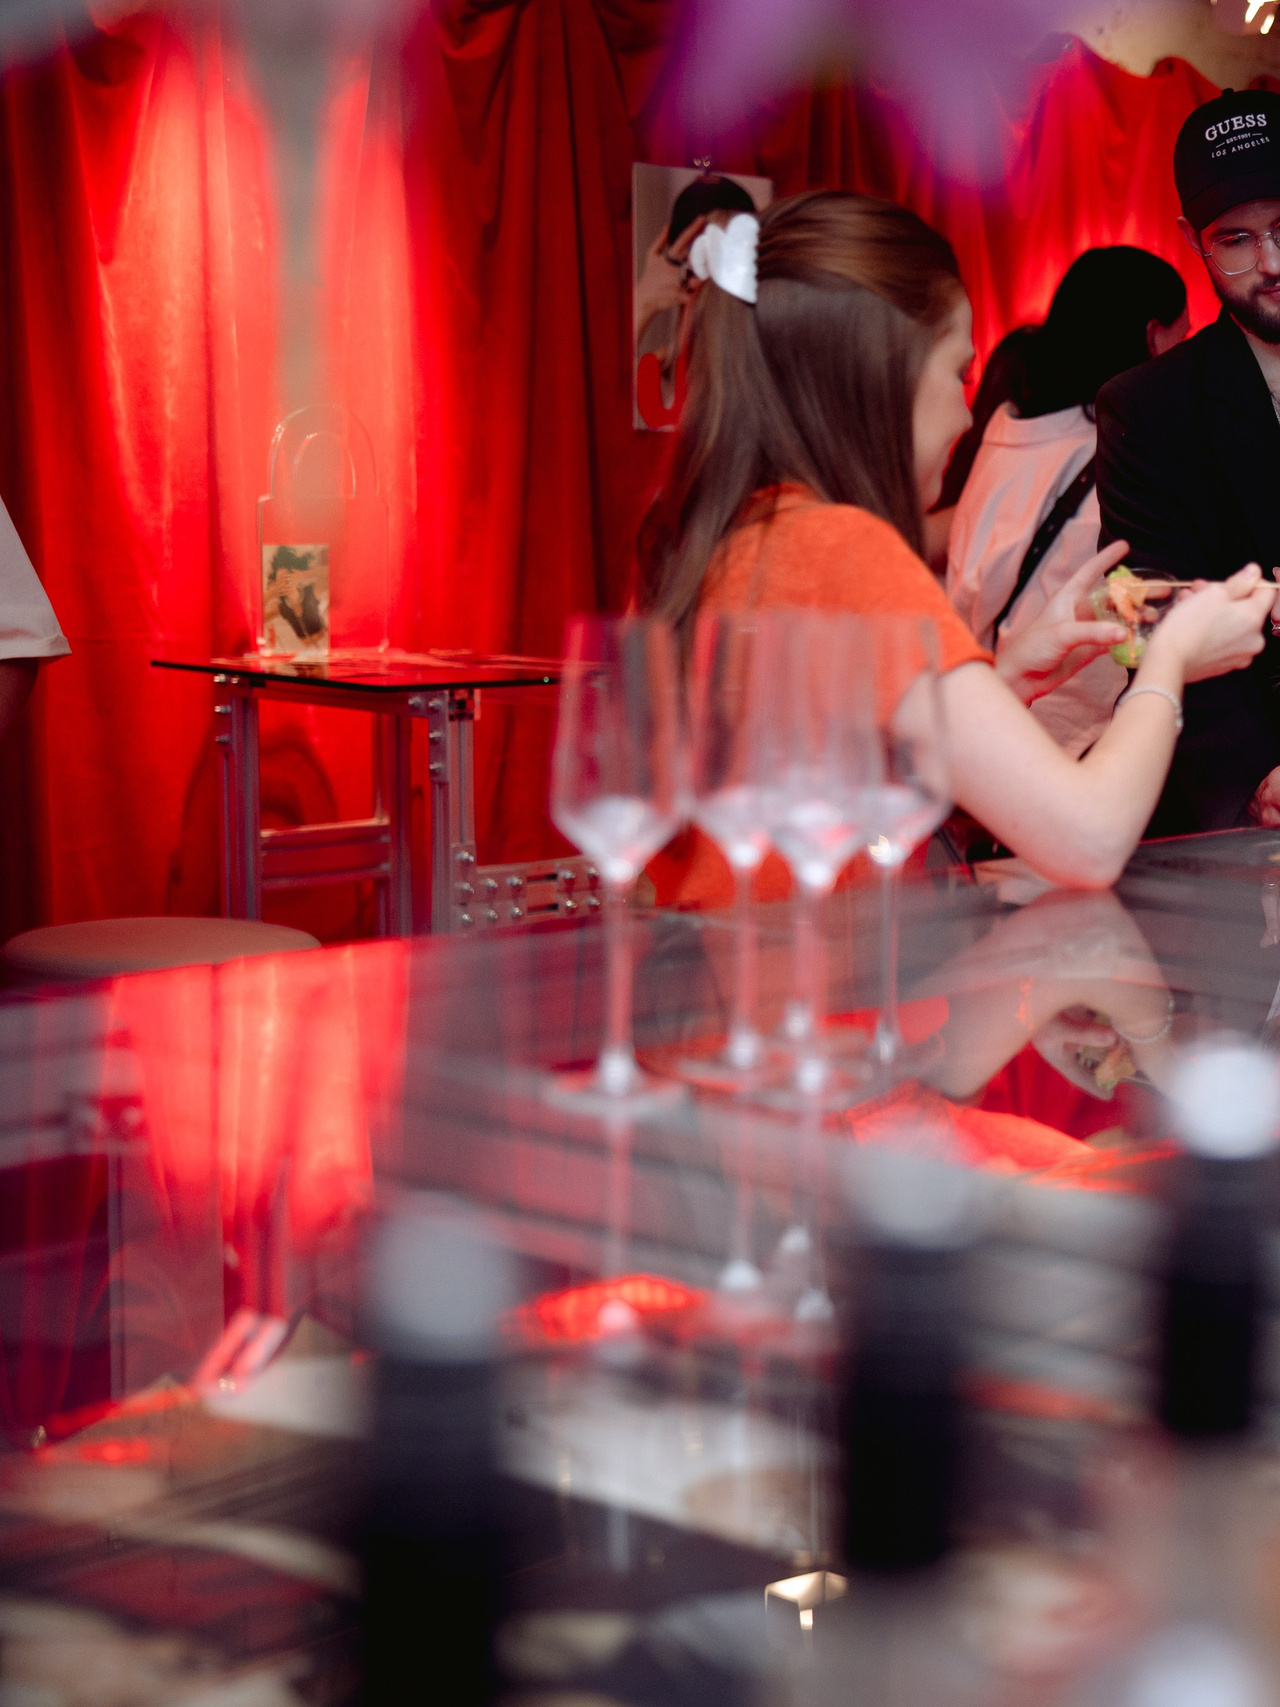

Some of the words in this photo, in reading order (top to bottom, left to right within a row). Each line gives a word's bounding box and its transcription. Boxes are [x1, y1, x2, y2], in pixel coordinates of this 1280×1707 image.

[1205, 113, 1267, 141] GUESS
[1211, 149, 1227, 158] LOS
[1231, 136, 1270, 153] ANGELES
